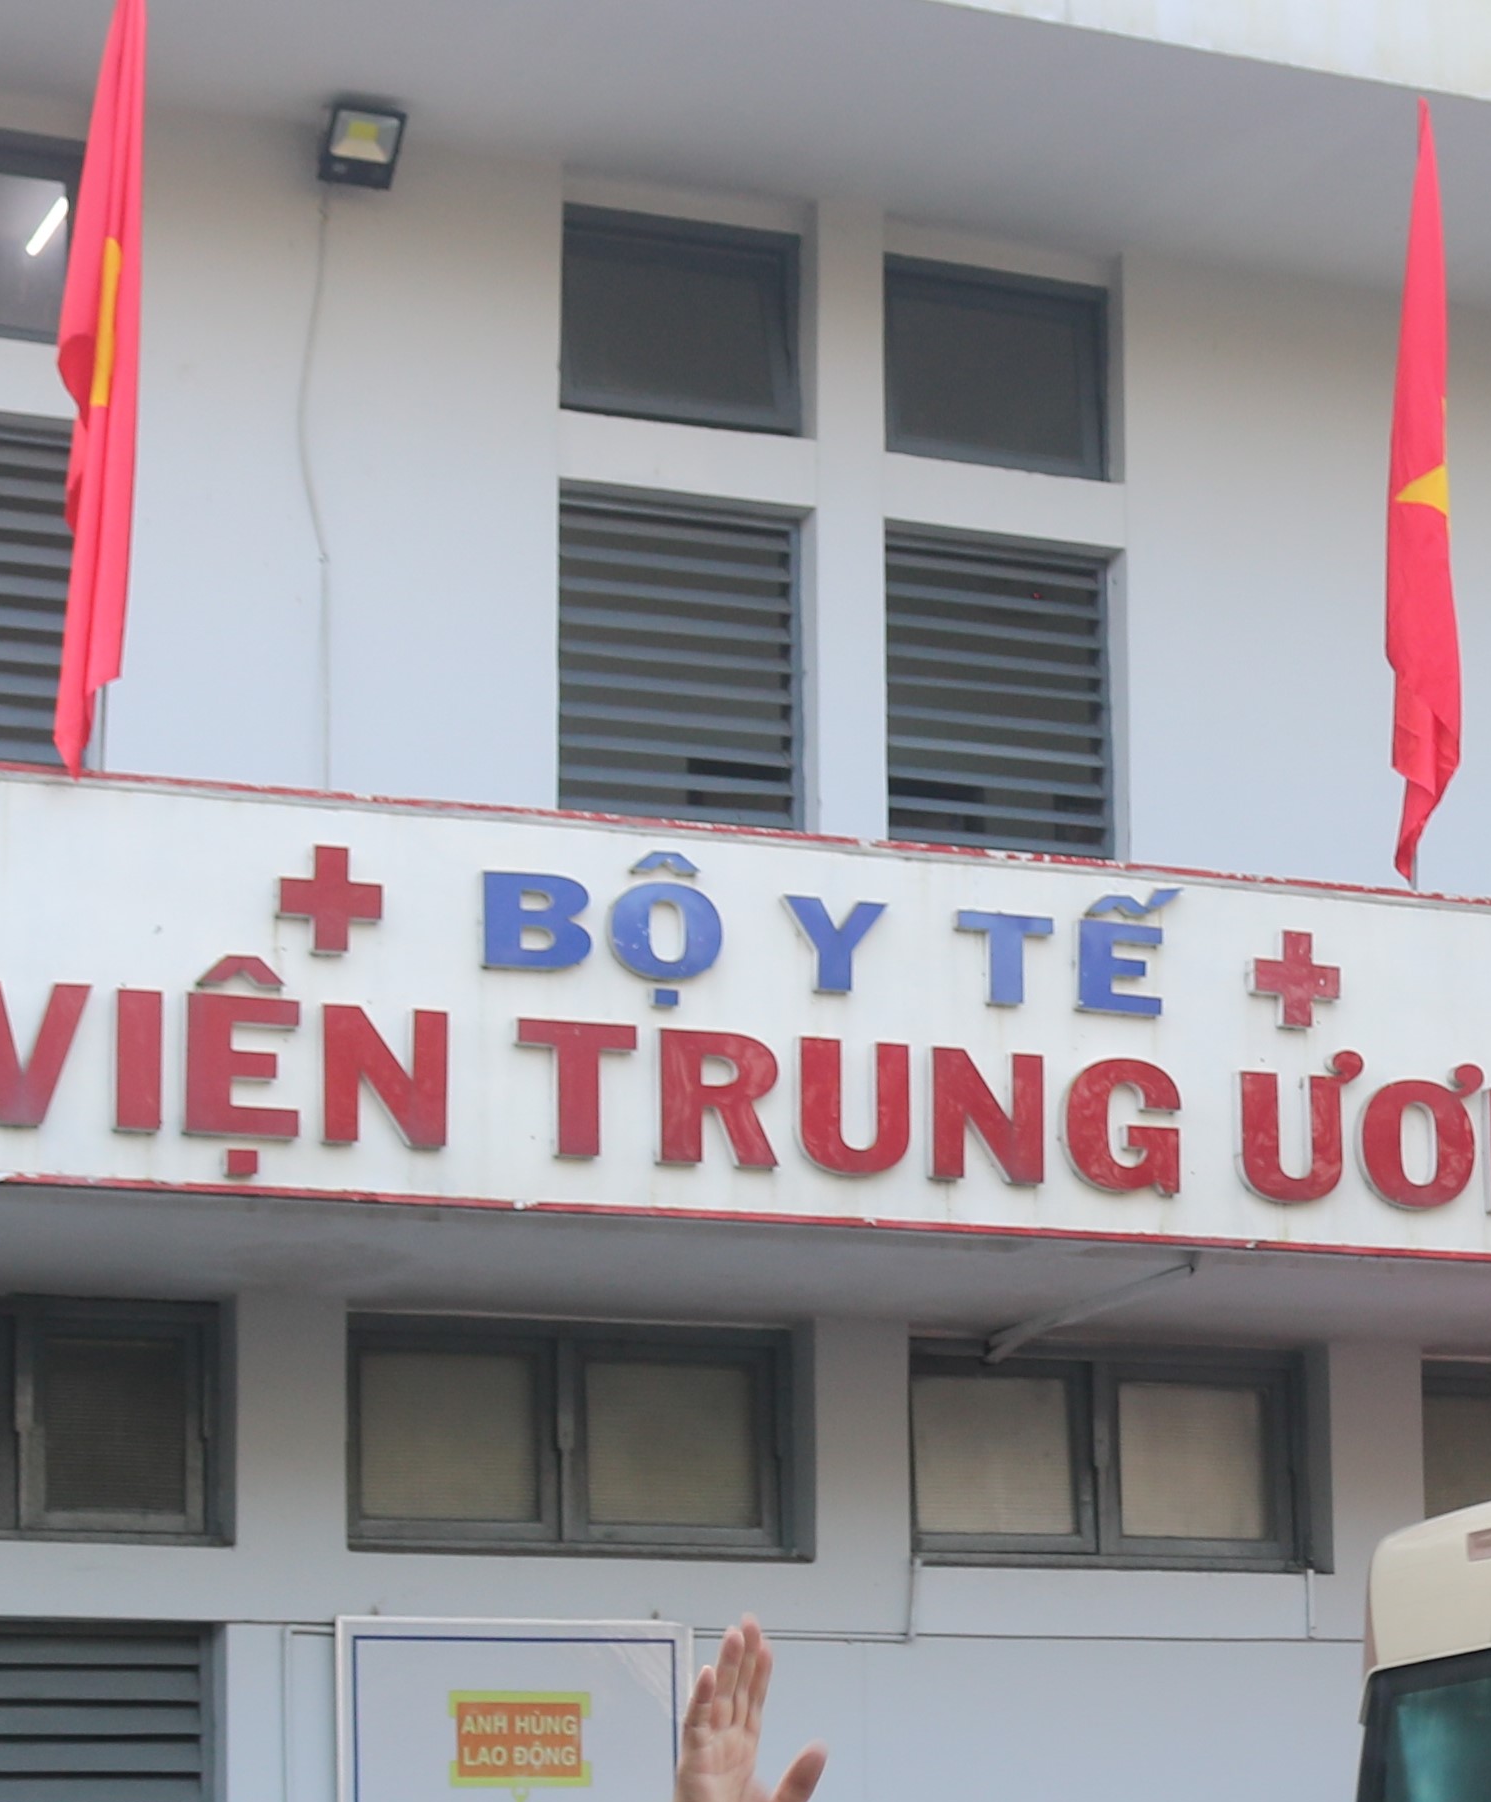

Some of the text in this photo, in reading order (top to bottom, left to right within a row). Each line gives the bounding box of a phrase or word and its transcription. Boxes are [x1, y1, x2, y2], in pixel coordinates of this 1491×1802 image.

[481, 850, 1180, 1017] BỘ Y TẾ
[517, 1018, 1181, 1197] TRUNG
[461, 1709, 579, 1736] ANH HÙNG
[462, 1741, 577, 1769] LAO ĐỘNG
